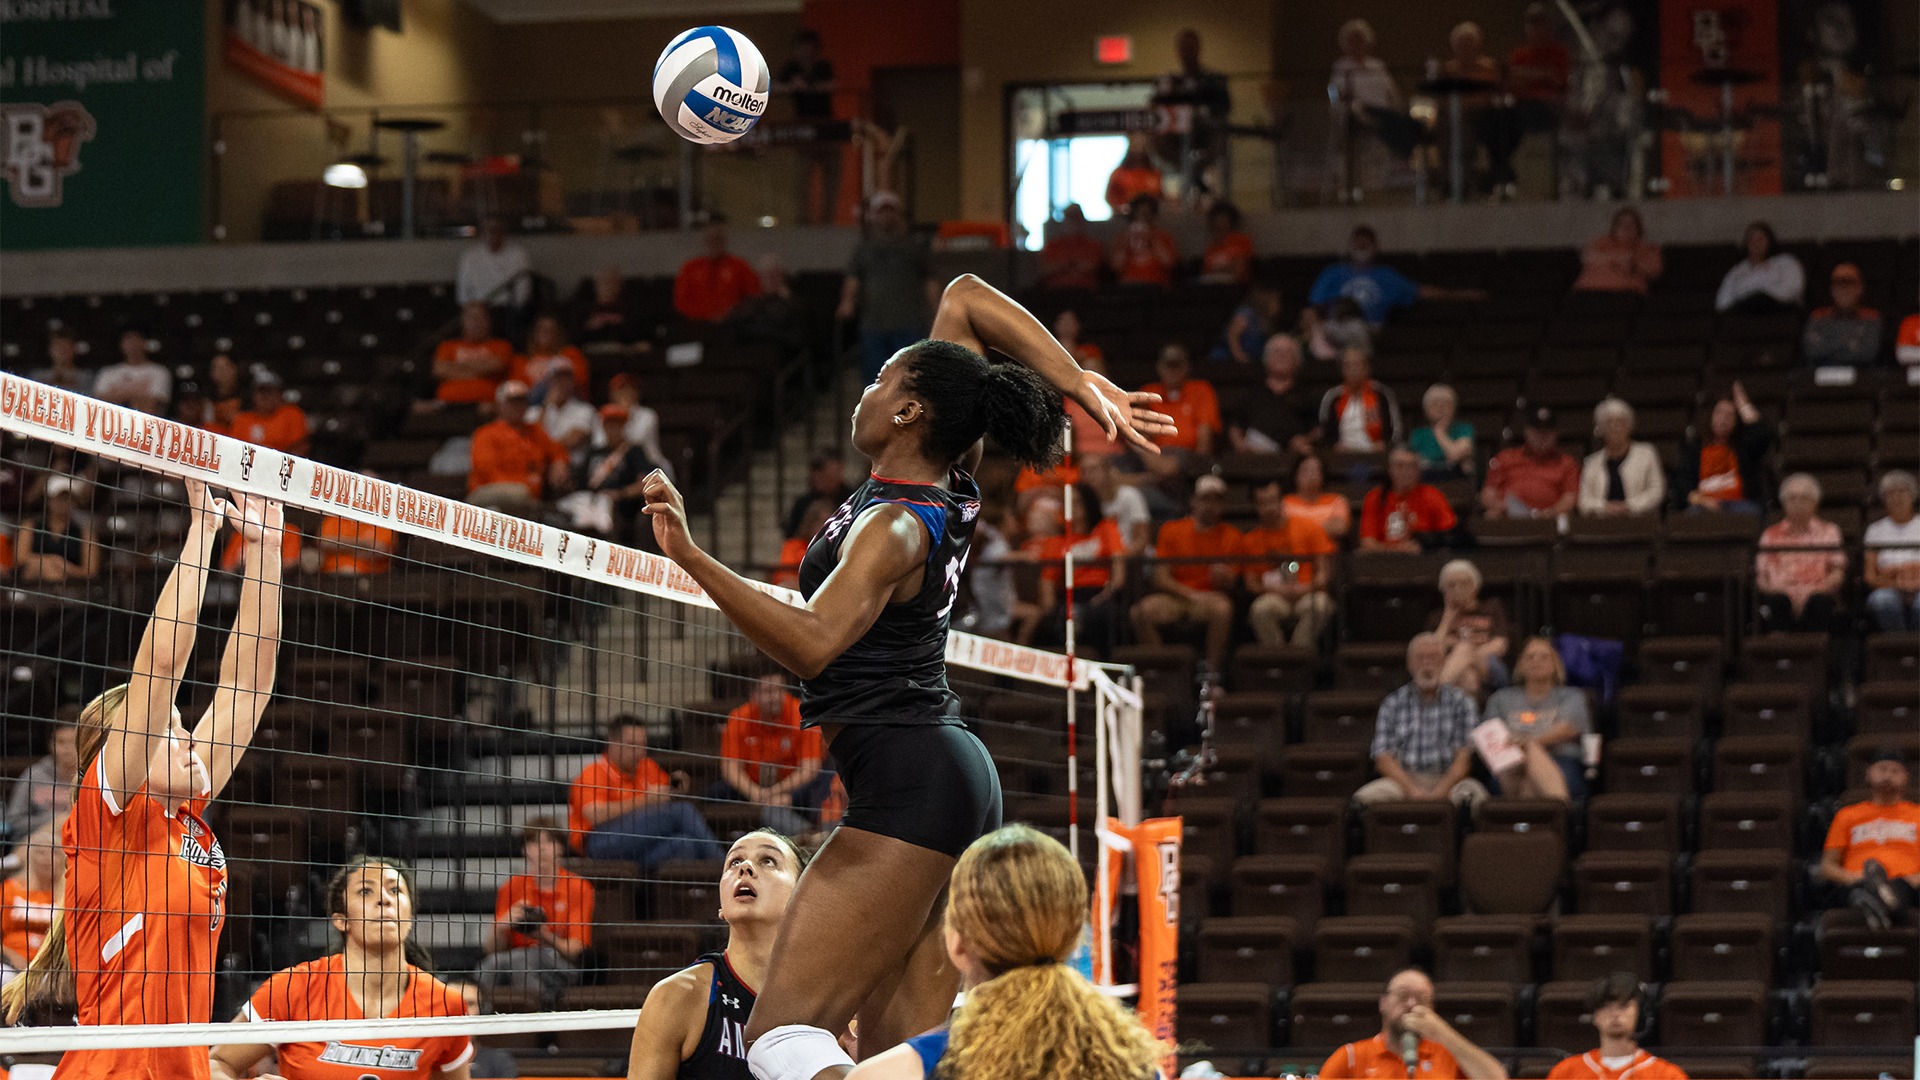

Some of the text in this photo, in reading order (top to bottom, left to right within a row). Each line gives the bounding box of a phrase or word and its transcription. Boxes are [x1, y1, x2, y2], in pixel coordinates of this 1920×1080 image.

[704, 106, 755, 132] NCAA
[713, 86, 764, 114] molten
[1, 378, 222, 474] GREEN VOLLEYBALL
[310, 464, 392, 519] BOWLING
[396, 483, 449, 534] GREEN
[452, 503, 545, 559] VOLLEYBALL
[606, 545, 666, 587] BOWLING
